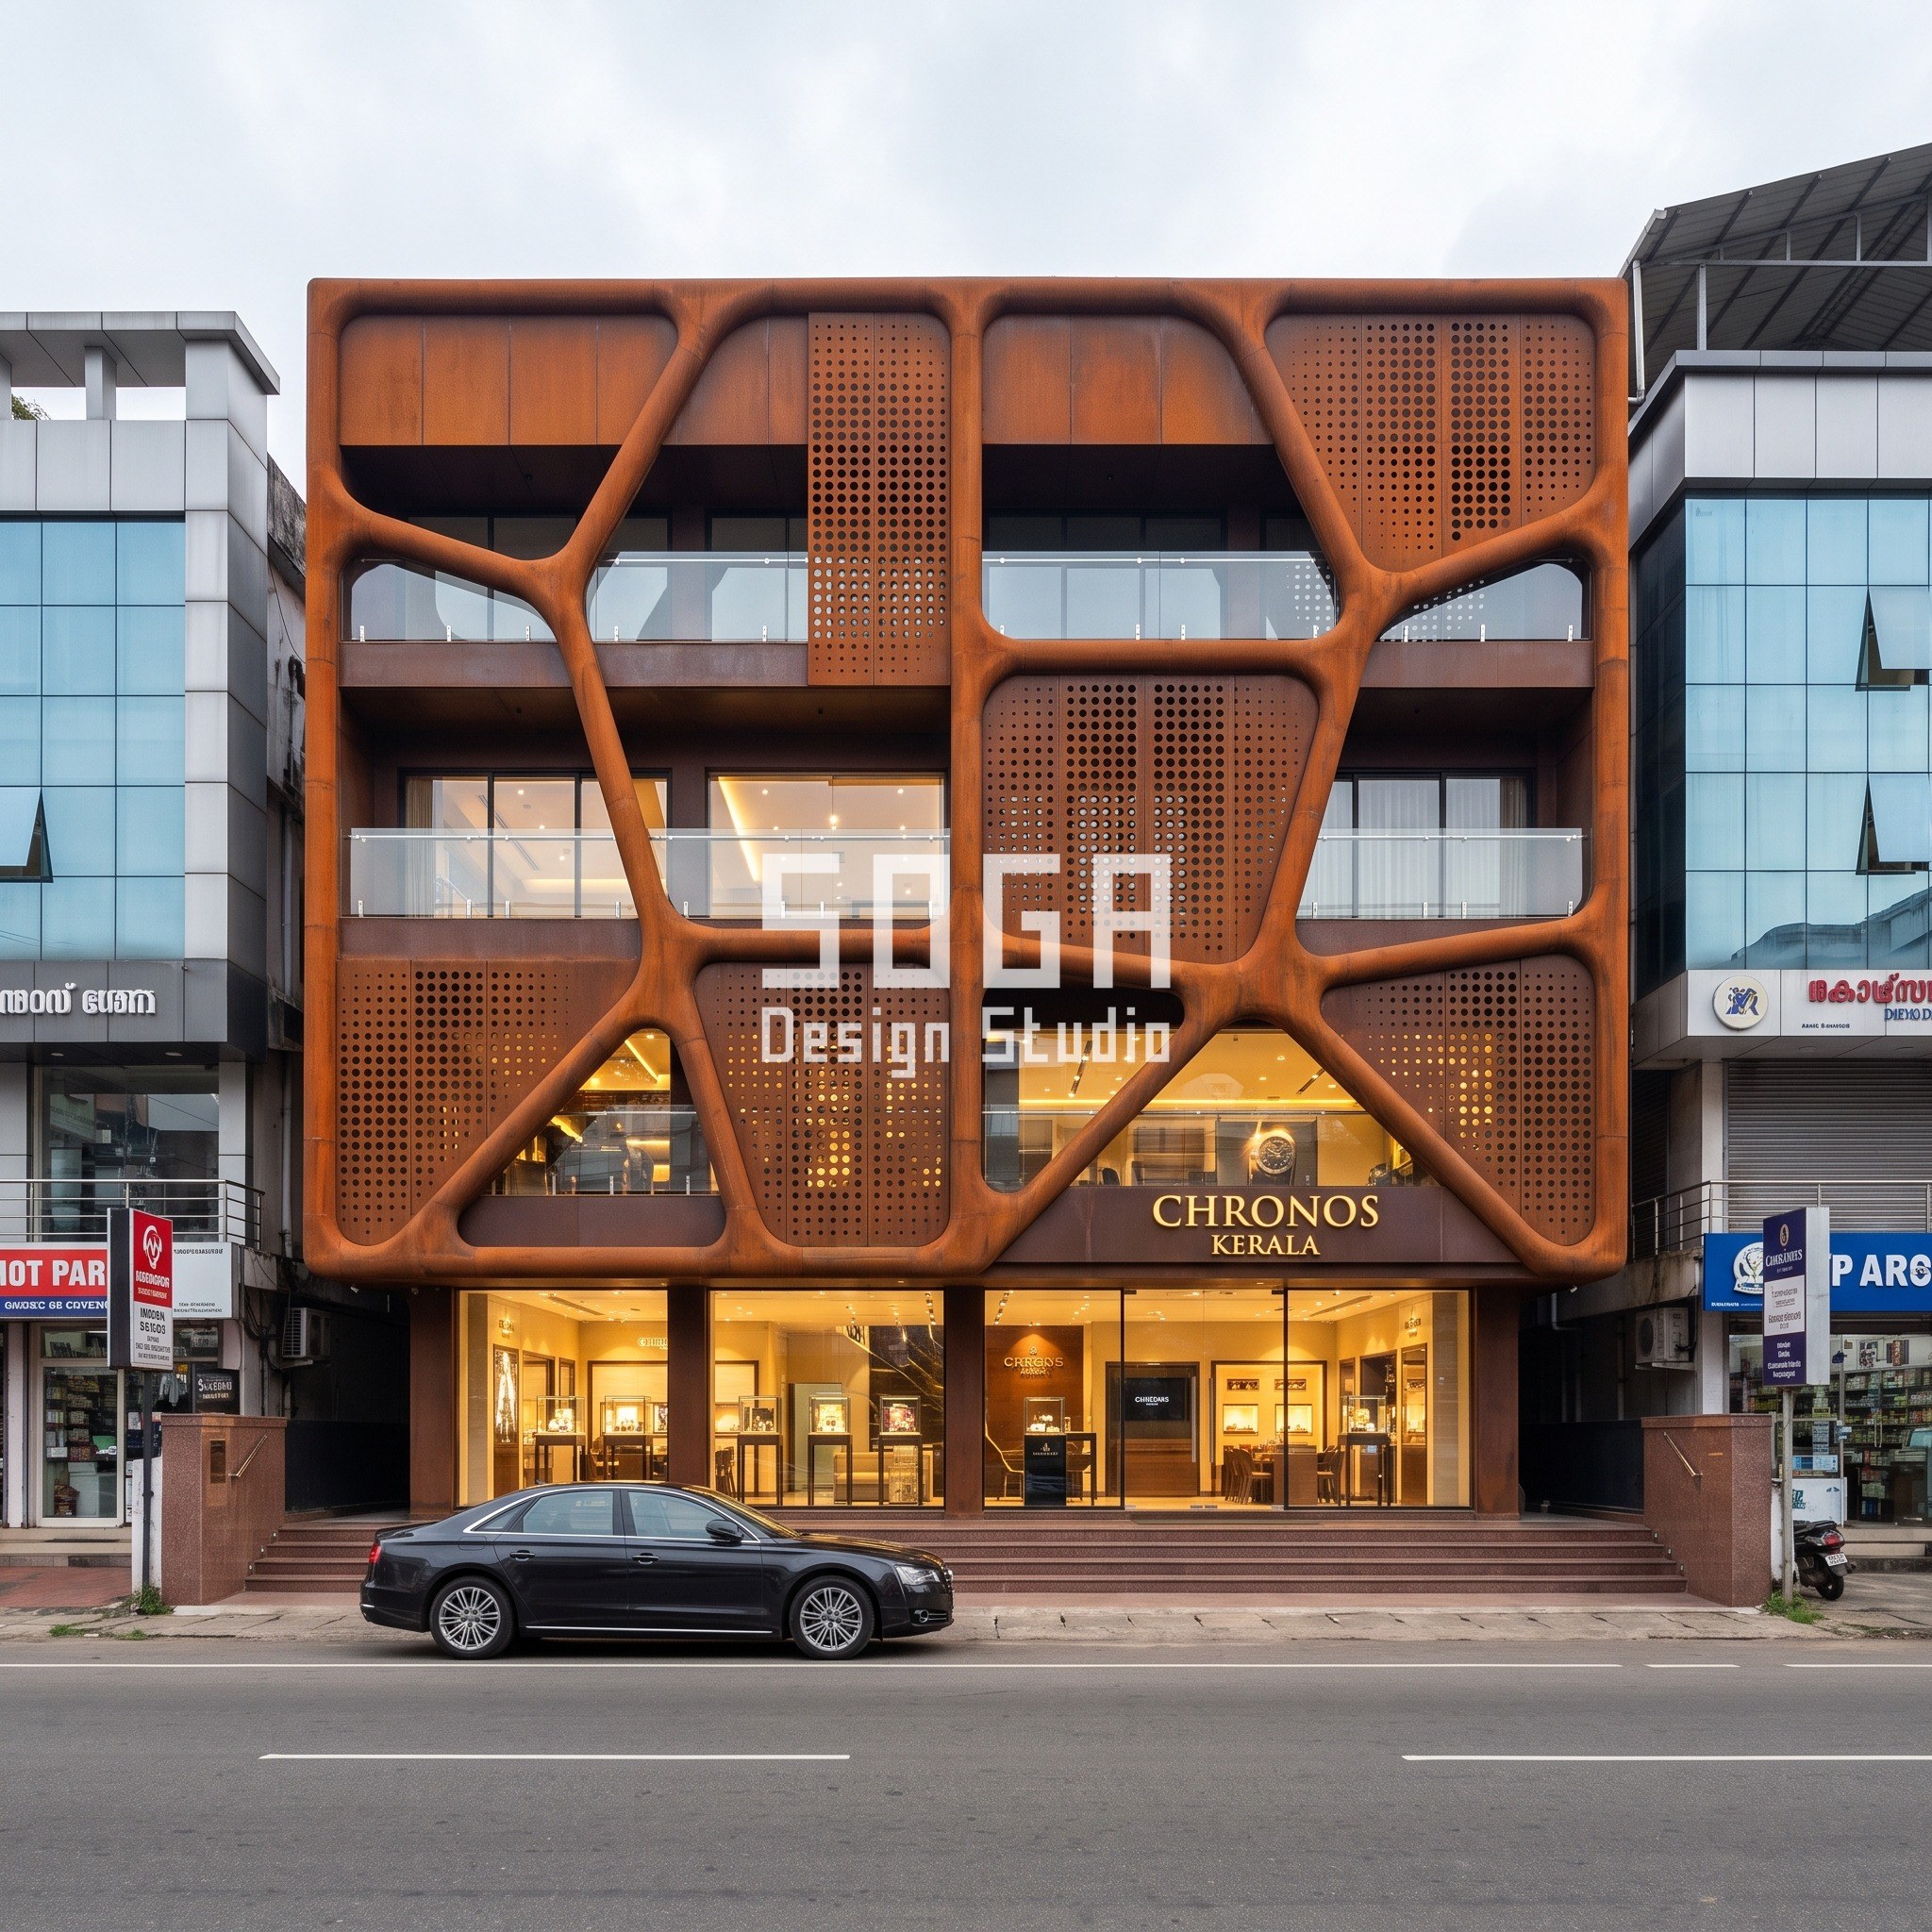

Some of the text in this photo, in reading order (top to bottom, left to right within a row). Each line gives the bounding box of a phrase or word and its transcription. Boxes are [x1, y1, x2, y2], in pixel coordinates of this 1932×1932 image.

[1153, 1195, 1379, 1227] CHRONOS
[1211, 1235, 1321, 1256] KERALA
[52, 1259, 106, 1286] PAR
[1829, 1254, 1854, 1287] P
